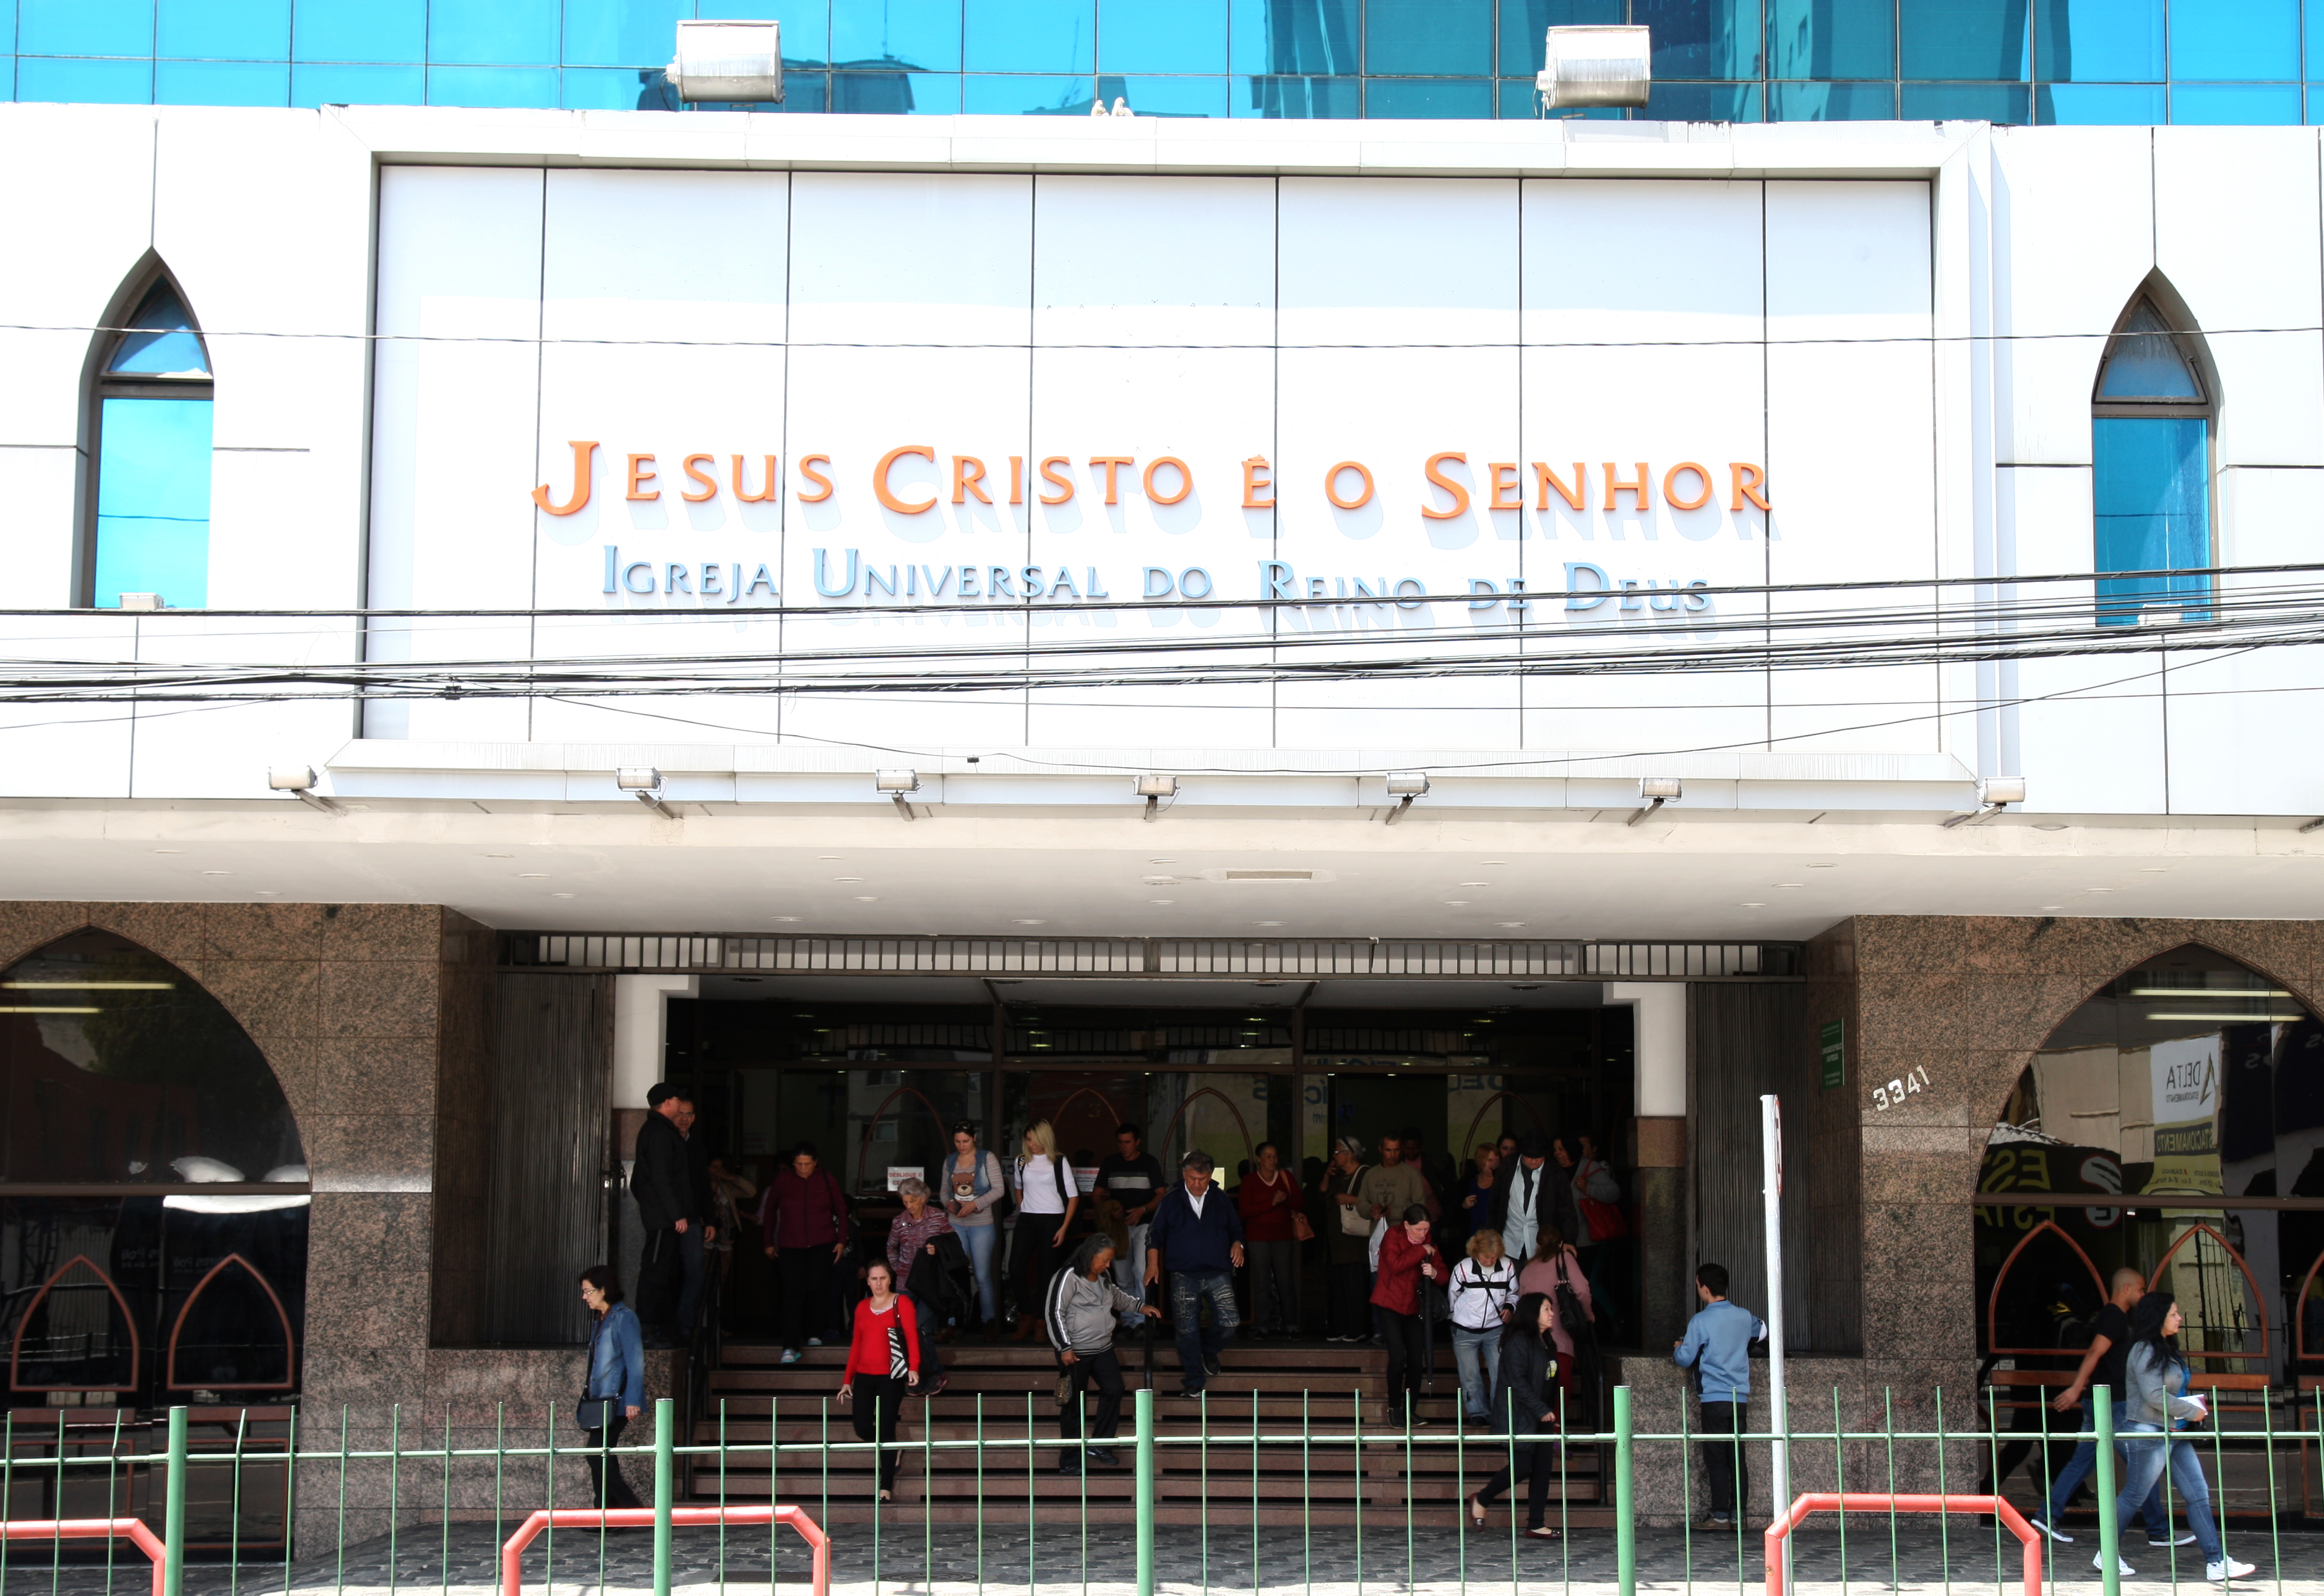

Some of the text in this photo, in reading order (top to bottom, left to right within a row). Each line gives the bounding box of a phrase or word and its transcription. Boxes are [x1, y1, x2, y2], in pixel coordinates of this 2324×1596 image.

[1325, 460, 1375, 509] O
[1143, 566, 1212, 598] DO
[1468, 577, 1530, 610] DE
[1564, 562, 1711, 611] DEUS
[1873, 1065, 1930, 1111] 3341
